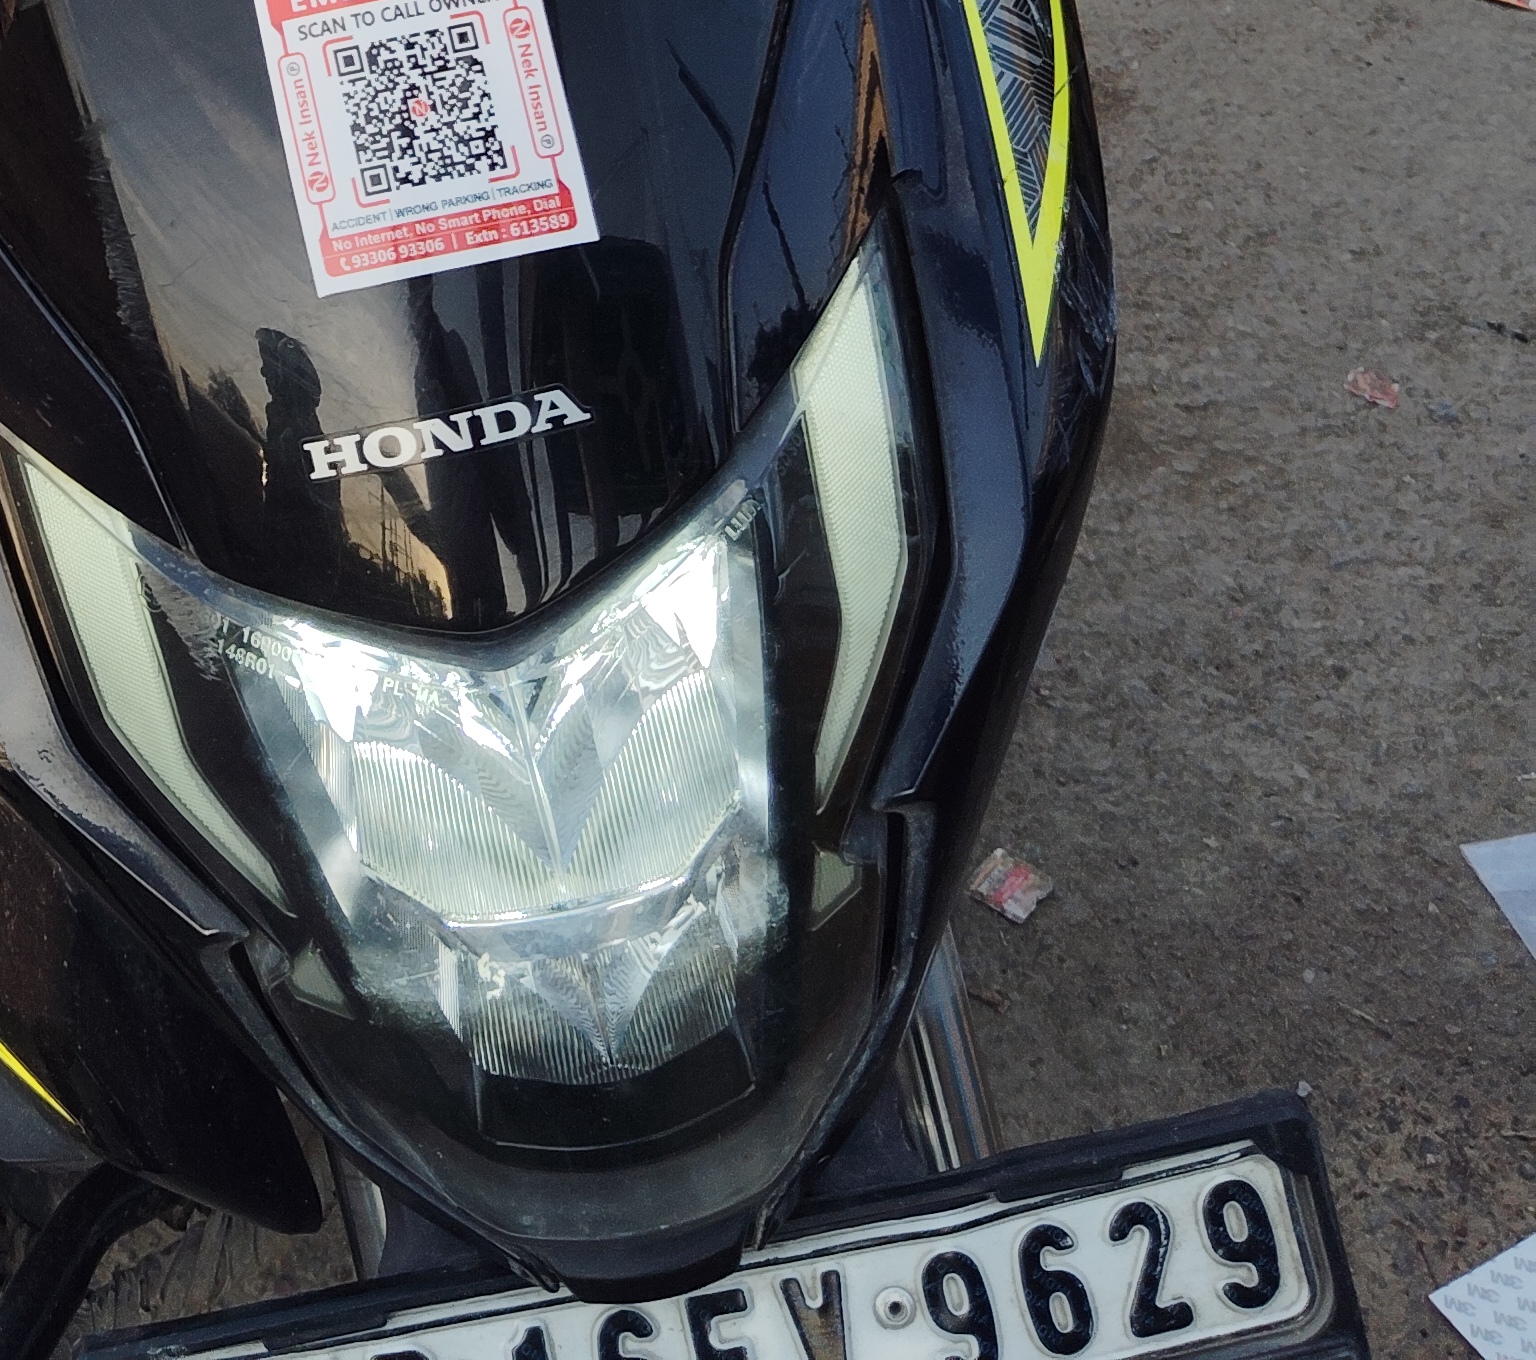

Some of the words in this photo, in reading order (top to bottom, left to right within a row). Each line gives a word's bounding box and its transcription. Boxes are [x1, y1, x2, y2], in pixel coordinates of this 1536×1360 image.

[297, 16, 346, 41] SCAN
[350, 9, 375, 29] TO
[515, 42, 538, 79] Nek
[291, 78, 314, 127] Insan
[526, 83, 548, 133] Insan
[300, 129, 323, 167] Nek
[331, 211, 388, 232] ACCIDENT
[394, 202, 438, 220] WRONG
[441, 191, 490, 211] PARKING
[496, 178, 554, 200] TRACKING
[332, 236, 352, 252] No
[354, 225, 412, 249] Internet,
[415, 219, 435, 235] No
[438, 211, 480, 231] Smart
[483, 202, 530, 225] Phone,
[533, 195, 561, 212] Dial
[351, 249, 396, 269] 93306
[398, 237, 445, 260] 93306
[465, 227, 499, 246] Extn
[509, 212, 570, 238] 613589
[303, 388, 592, 480] HONDA
[921, 1178, 1280, 1360] 9629
